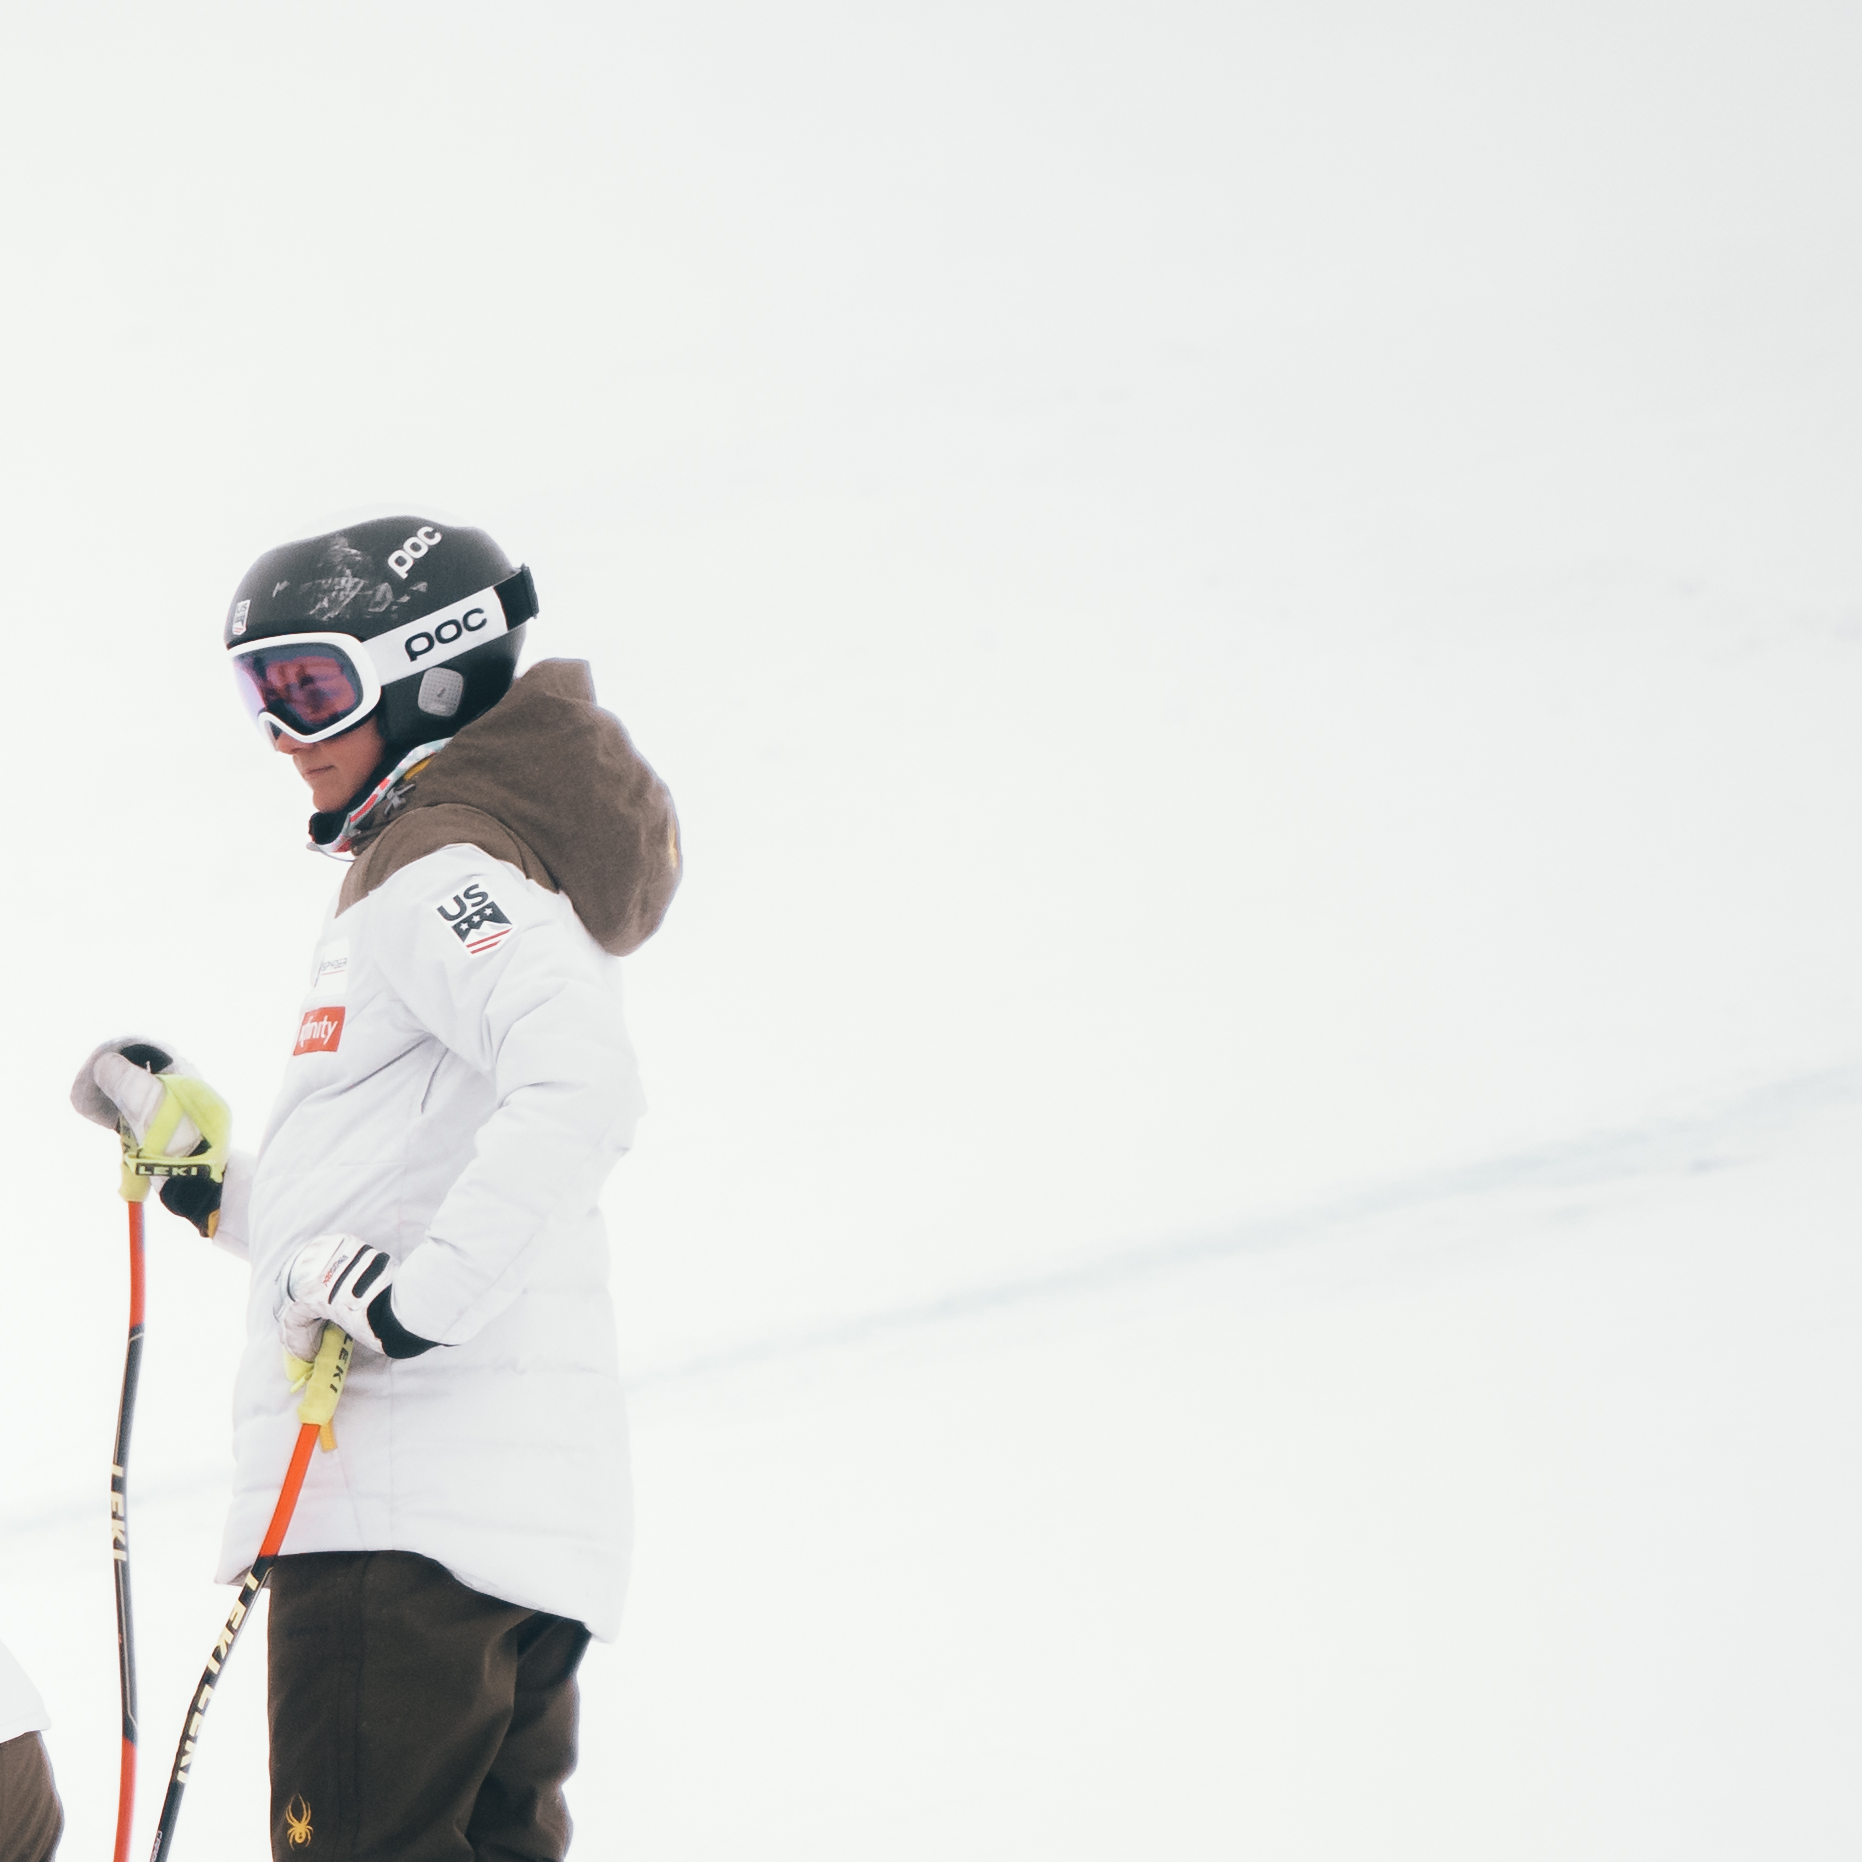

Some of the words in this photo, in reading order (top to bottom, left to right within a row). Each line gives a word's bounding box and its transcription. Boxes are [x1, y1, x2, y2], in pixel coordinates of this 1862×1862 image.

[436, 884, 489, 922] US
[138, 1166, 198, 1176] LEKI
[110, 1463, 127, 1562] LEKI
